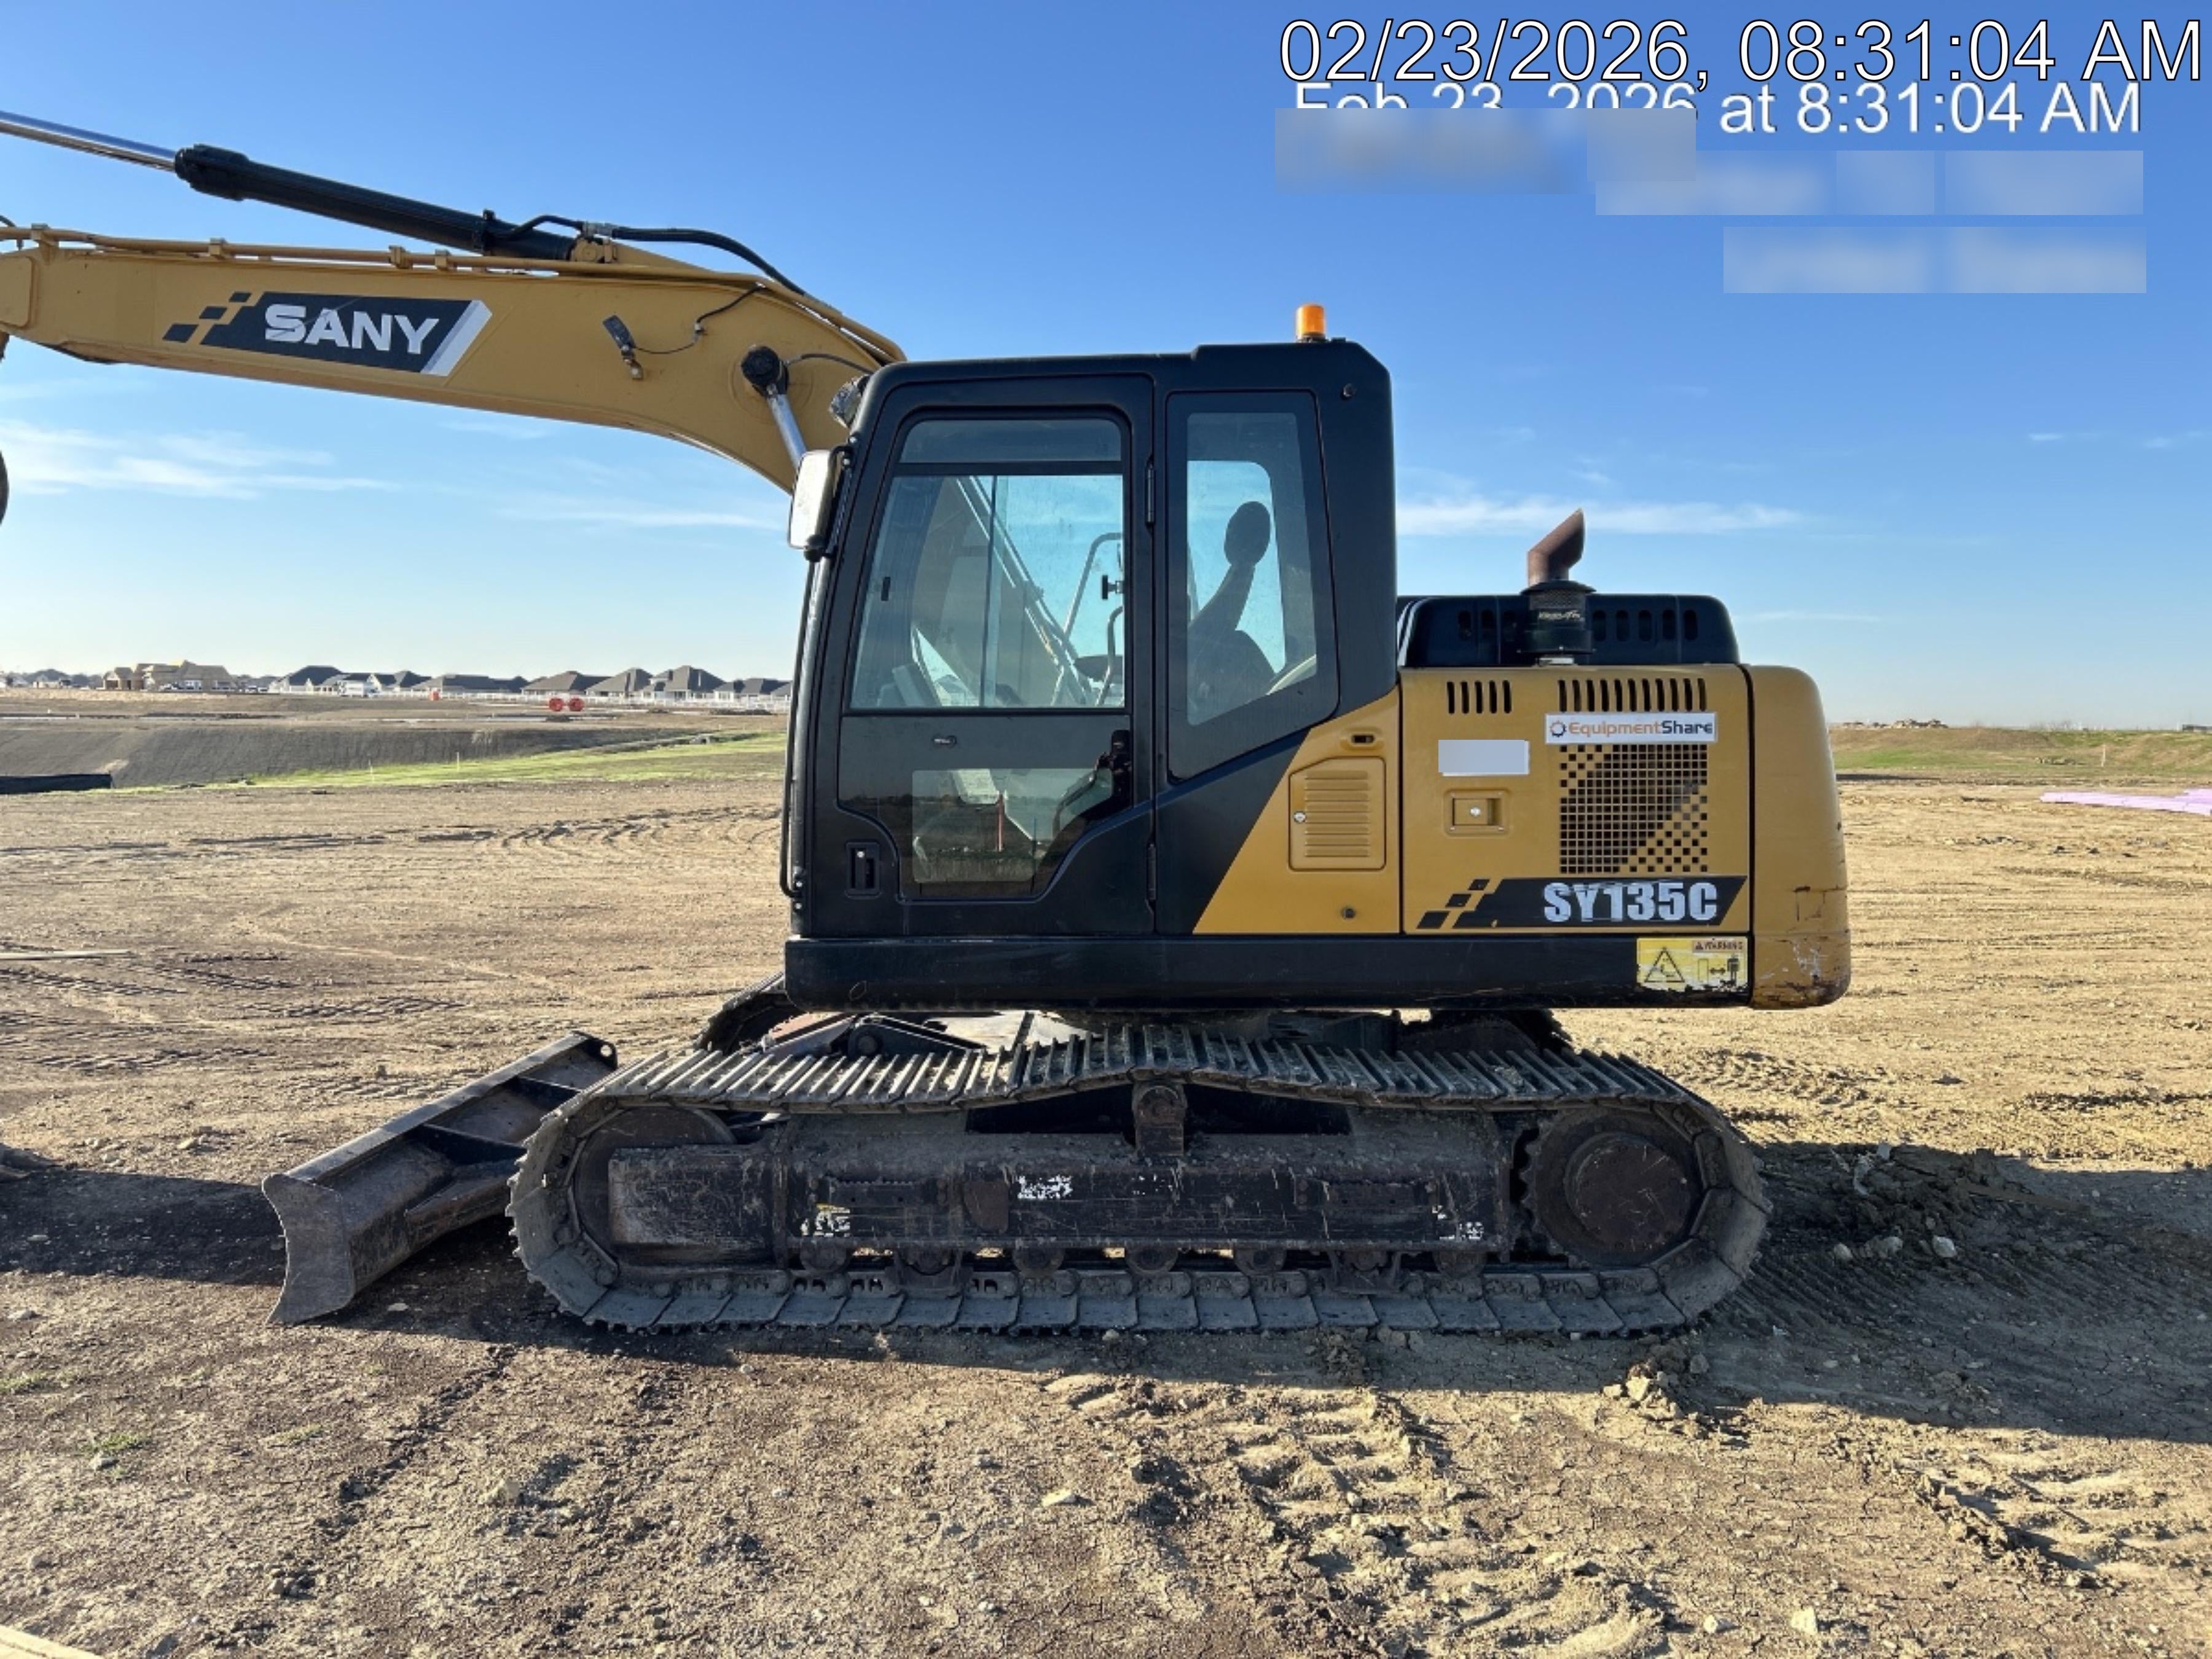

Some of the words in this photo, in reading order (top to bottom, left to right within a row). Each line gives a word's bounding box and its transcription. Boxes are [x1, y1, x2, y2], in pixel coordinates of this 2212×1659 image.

[265, 304, 439, 355] SANY
[1569, 720, 1712, 737] EquipmentShare
[1543, 882, 1717, 922] SY135C
